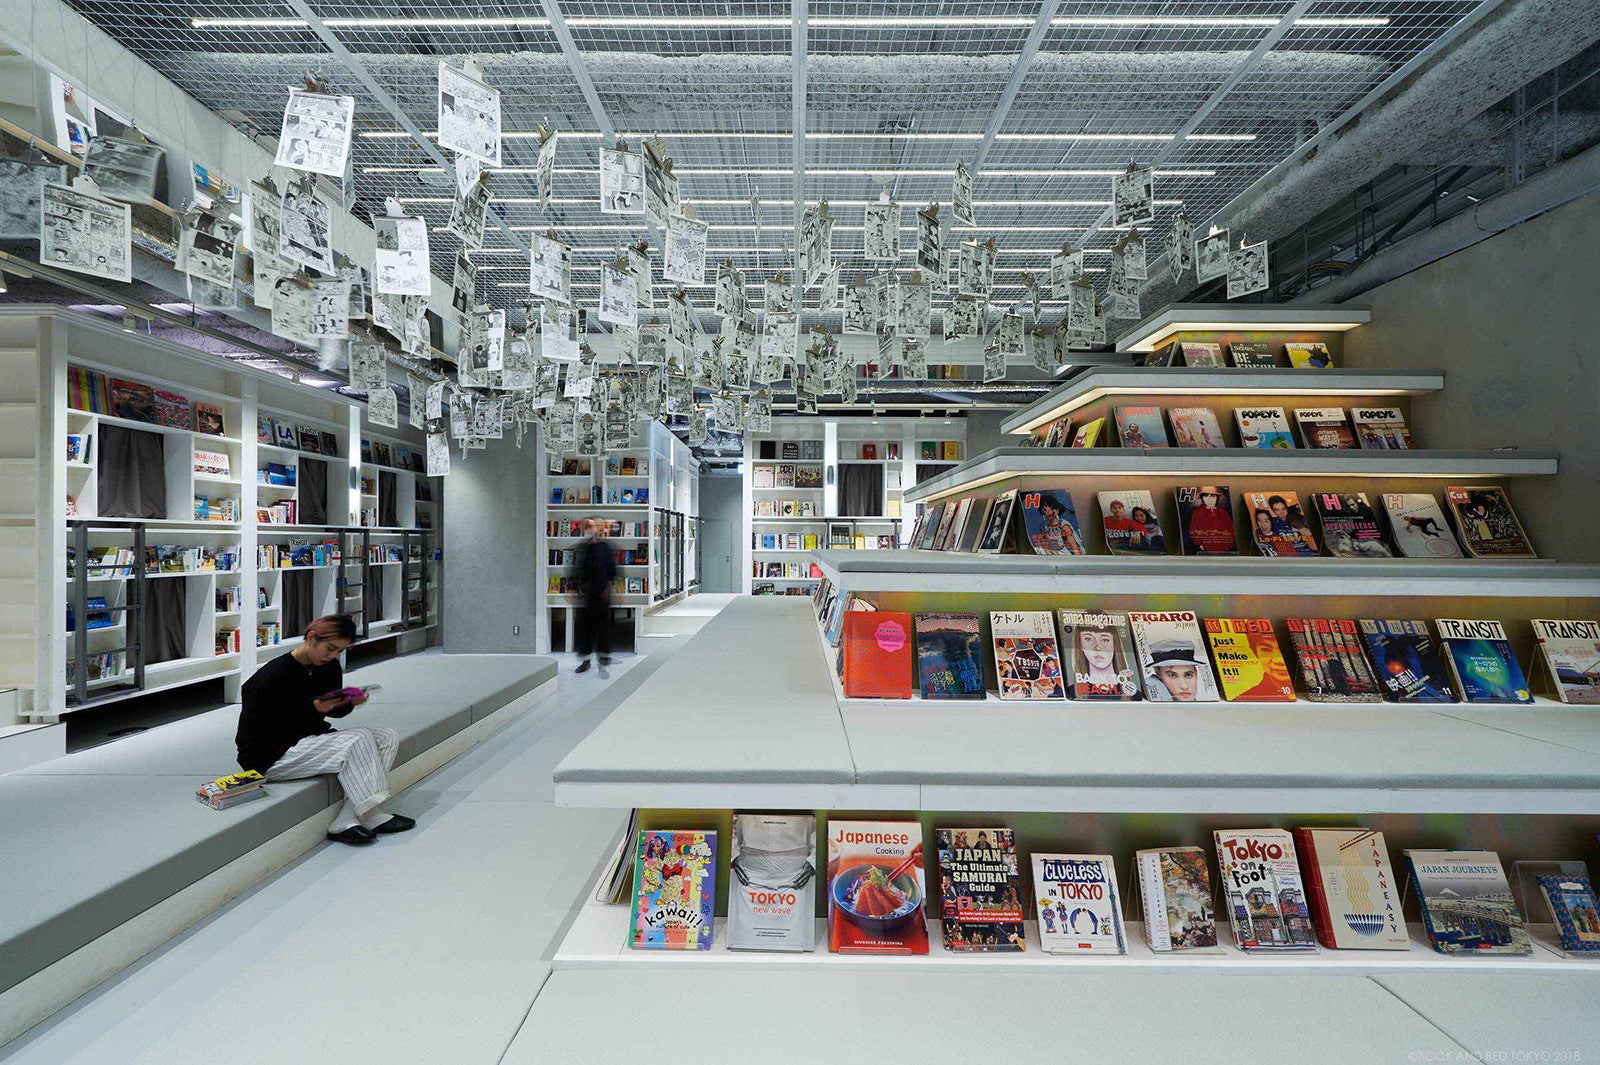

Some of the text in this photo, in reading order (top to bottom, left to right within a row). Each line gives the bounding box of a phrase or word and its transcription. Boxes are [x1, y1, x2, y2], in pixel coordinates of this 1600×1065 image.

[1241, 410, 1280, 419] POPEYE
[1359, 410, 1396, 419] POPEYE
[277, 425, 294, 440] LA
[1024, 493, 1041, 509] H
[1179, 487, 1197, 503] H
[1322, 493, 1342, 511] H
[1387, 495, 1404, 509] H
[993, 613, 1025, 625] ケトル
[1063, 613, 1084, 624] anna
[1084, 613, 1126, 629] magazine
[1130, 612, 1194, 623] FIGARO
[1204, 618, 1274, 633] WIRED
[1286, 618, 1357, 634] WIRED
[1359, 619, 1430, 635] WIRED
[1441, 620, 1502, 639] TRANSIT
[1538, 620, 1600, 640] TRANSIT
[1213, 637, 1235, 648] Just
[1218, 652, 1248, 661] Make
[1281, 686, 1291, 695] 10
[1442, 687, 1452, 695] 11
[835, 829, 909, 845] Japanese
[875, 847, 905, 856] Cooking
[955, 848, 1002, 862] JAPAN
[950, 862, 1008, 872] The Ultimate
[1240, 861, 1257, 871] on
[1421, 865, 1498, 874] JAPAN JOURNEYS
[952, 871, 1008, 883] SAMURAI
[969, 883, 996, 892] Guide
[1057, 883, 1103, 900] TOKYO
[749, 891, 796, 906] TOKYO
[645, 907, 703, 929] kawaii!
[771, 907, 792, 915] wave
